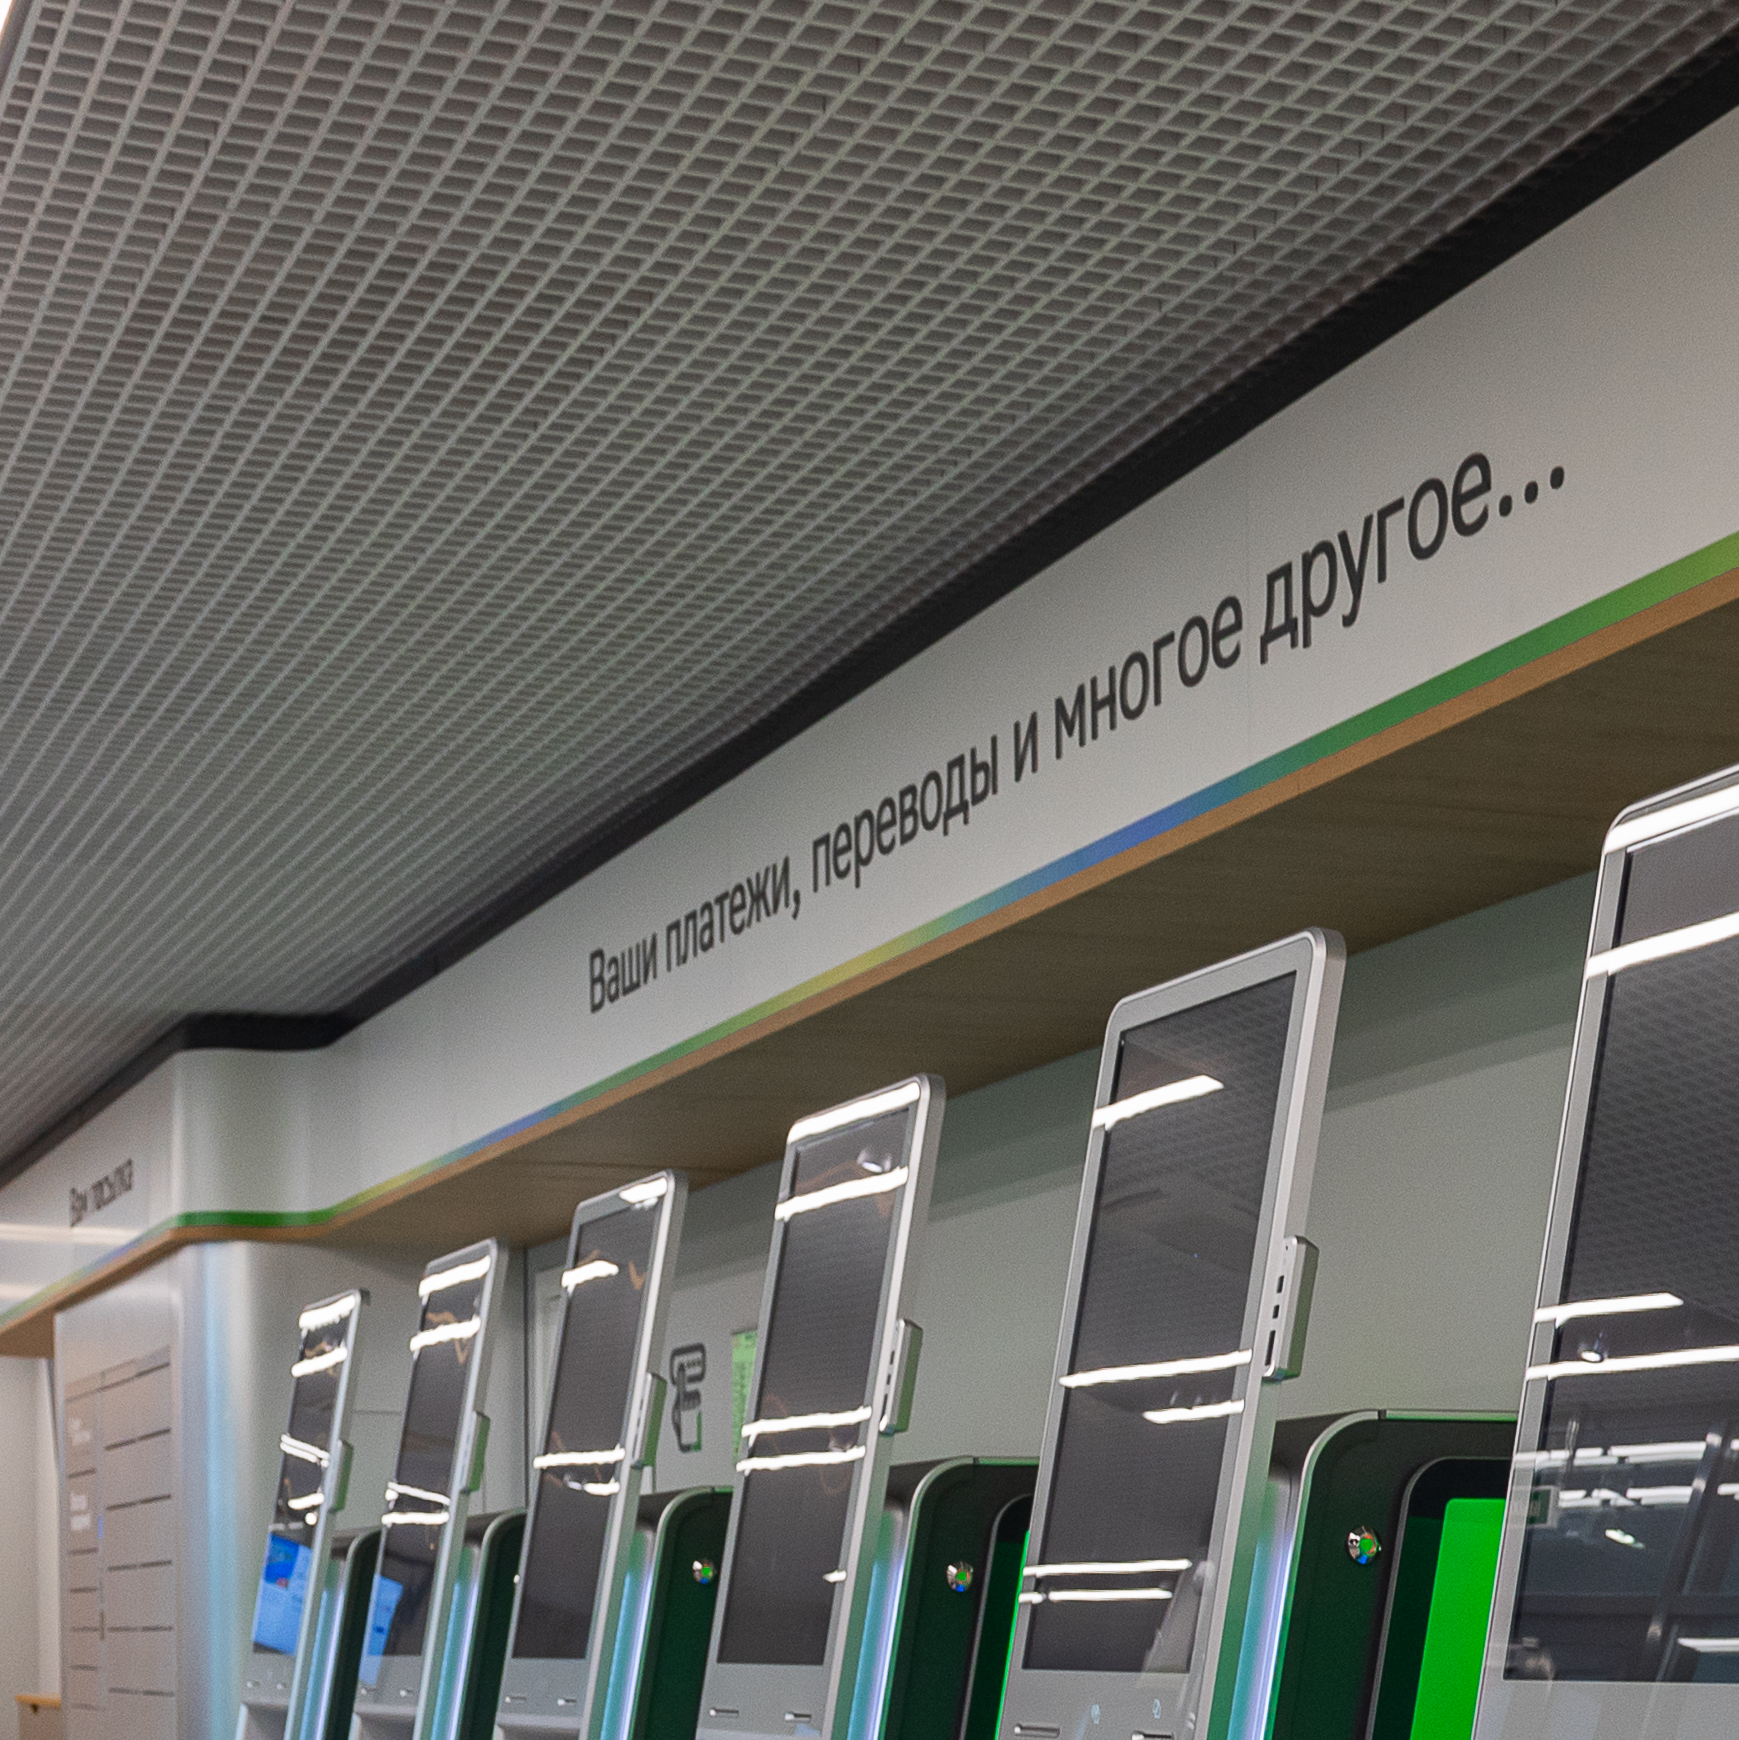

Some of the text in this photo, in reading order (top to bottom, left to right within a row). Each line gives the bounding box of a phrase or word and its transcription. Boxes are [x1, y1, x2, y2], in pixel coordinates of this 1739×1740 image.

[589, 451, 1566, 1014] Ваши платежи, переводы и многое другое...
